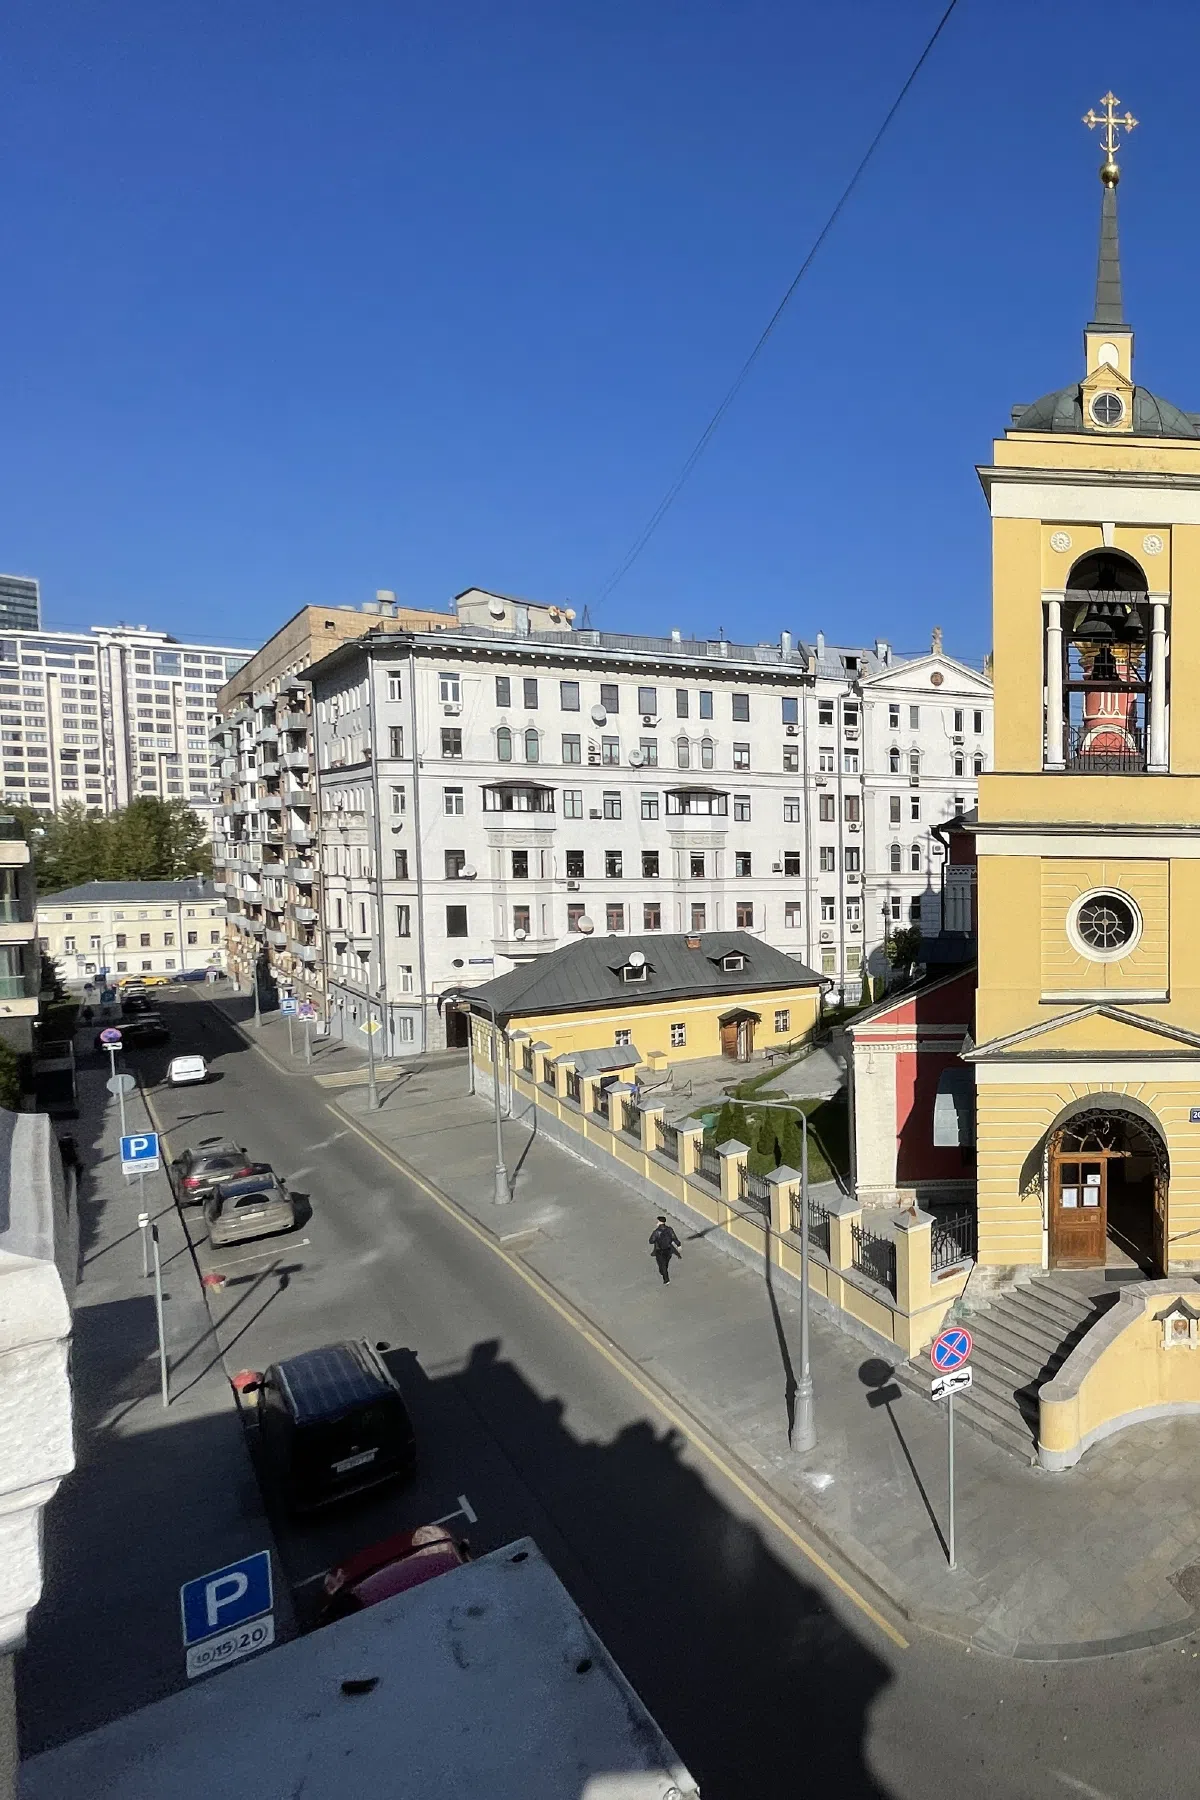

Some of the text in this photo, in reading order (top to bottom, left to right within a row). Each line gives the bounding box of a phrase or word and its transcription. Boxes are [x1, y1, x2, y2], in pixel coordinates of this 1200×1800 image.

[130, 1137, 149, 1158] P
[206, 1571, 249, 1627] P
[240, 1628, 264, 1648] 20
